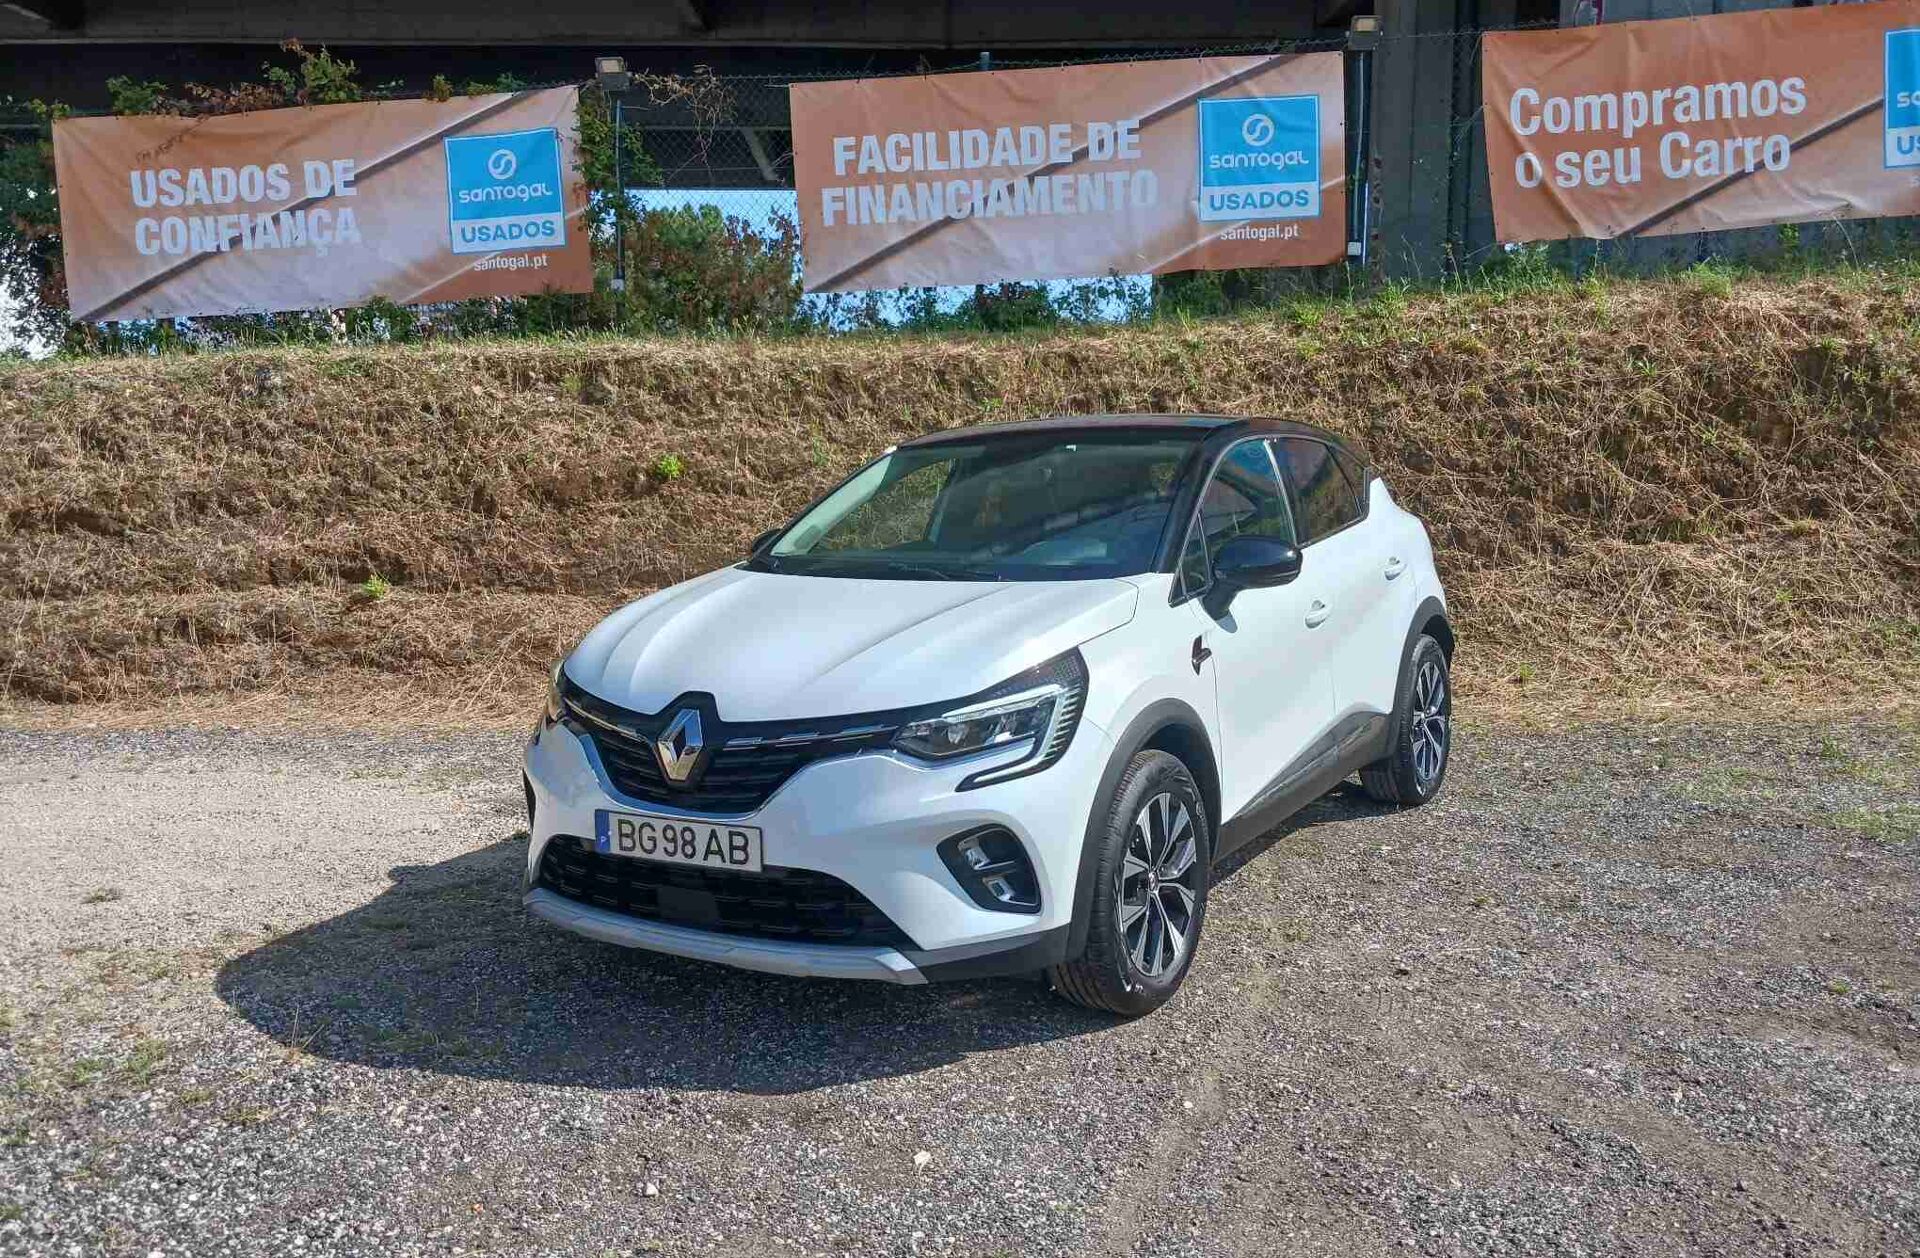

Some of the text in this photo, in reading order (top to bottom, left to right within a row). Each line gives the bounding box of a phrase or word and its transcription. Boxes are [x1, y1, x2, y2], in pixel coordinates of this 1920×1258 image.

[1510, 76, 1806, 138] Compramos
[833, 119, 1142, 176] FACILIDADE DE
[1209, 150, 1309, 170] santogal
[1515, 131, 1790, 188] o seu Carro
[130, 159, 357, 208] USADOS DE
[458, 183, 553, 203] santogal
[821, 169, 1160, 227] FINANCIAMENTO
[1210, 189, 1309, 211] USADOS
[135, 206, 362, 256] CONFIANÇA
[461, 220, 555, 243] USADOS
[1220, 224, 1298, 241] santogal.pt
[474, 253, 548, 271] santogal.pt
